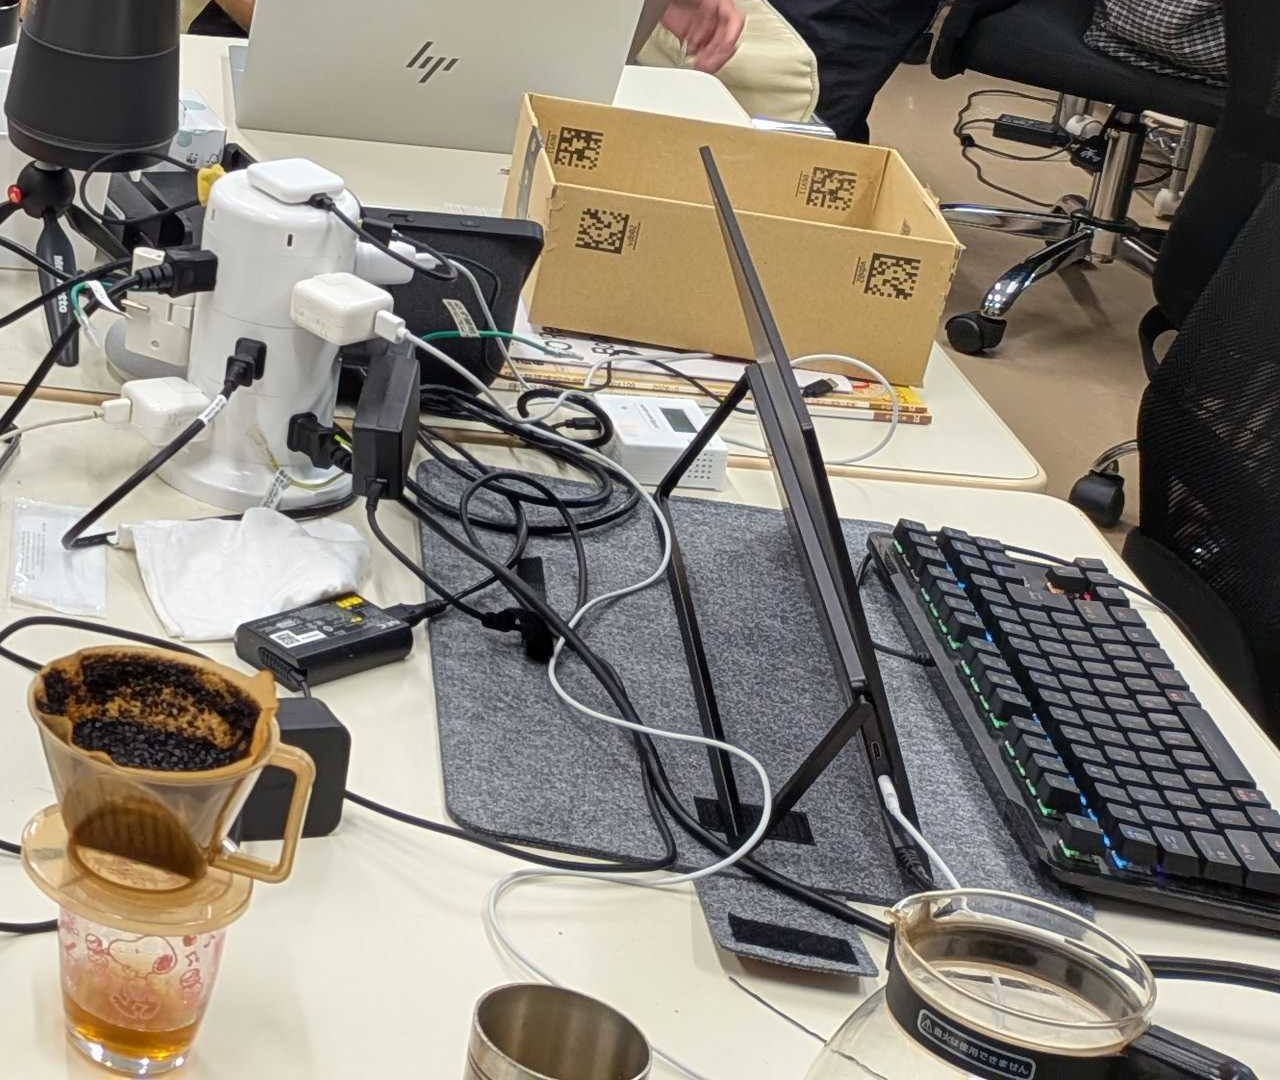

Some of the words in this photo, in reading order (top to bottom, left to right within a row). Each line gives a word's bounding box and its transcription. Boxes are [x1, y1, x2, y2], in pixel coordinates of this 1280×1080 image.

[933, 1025, 1030, 1076] 直火は使用できません
